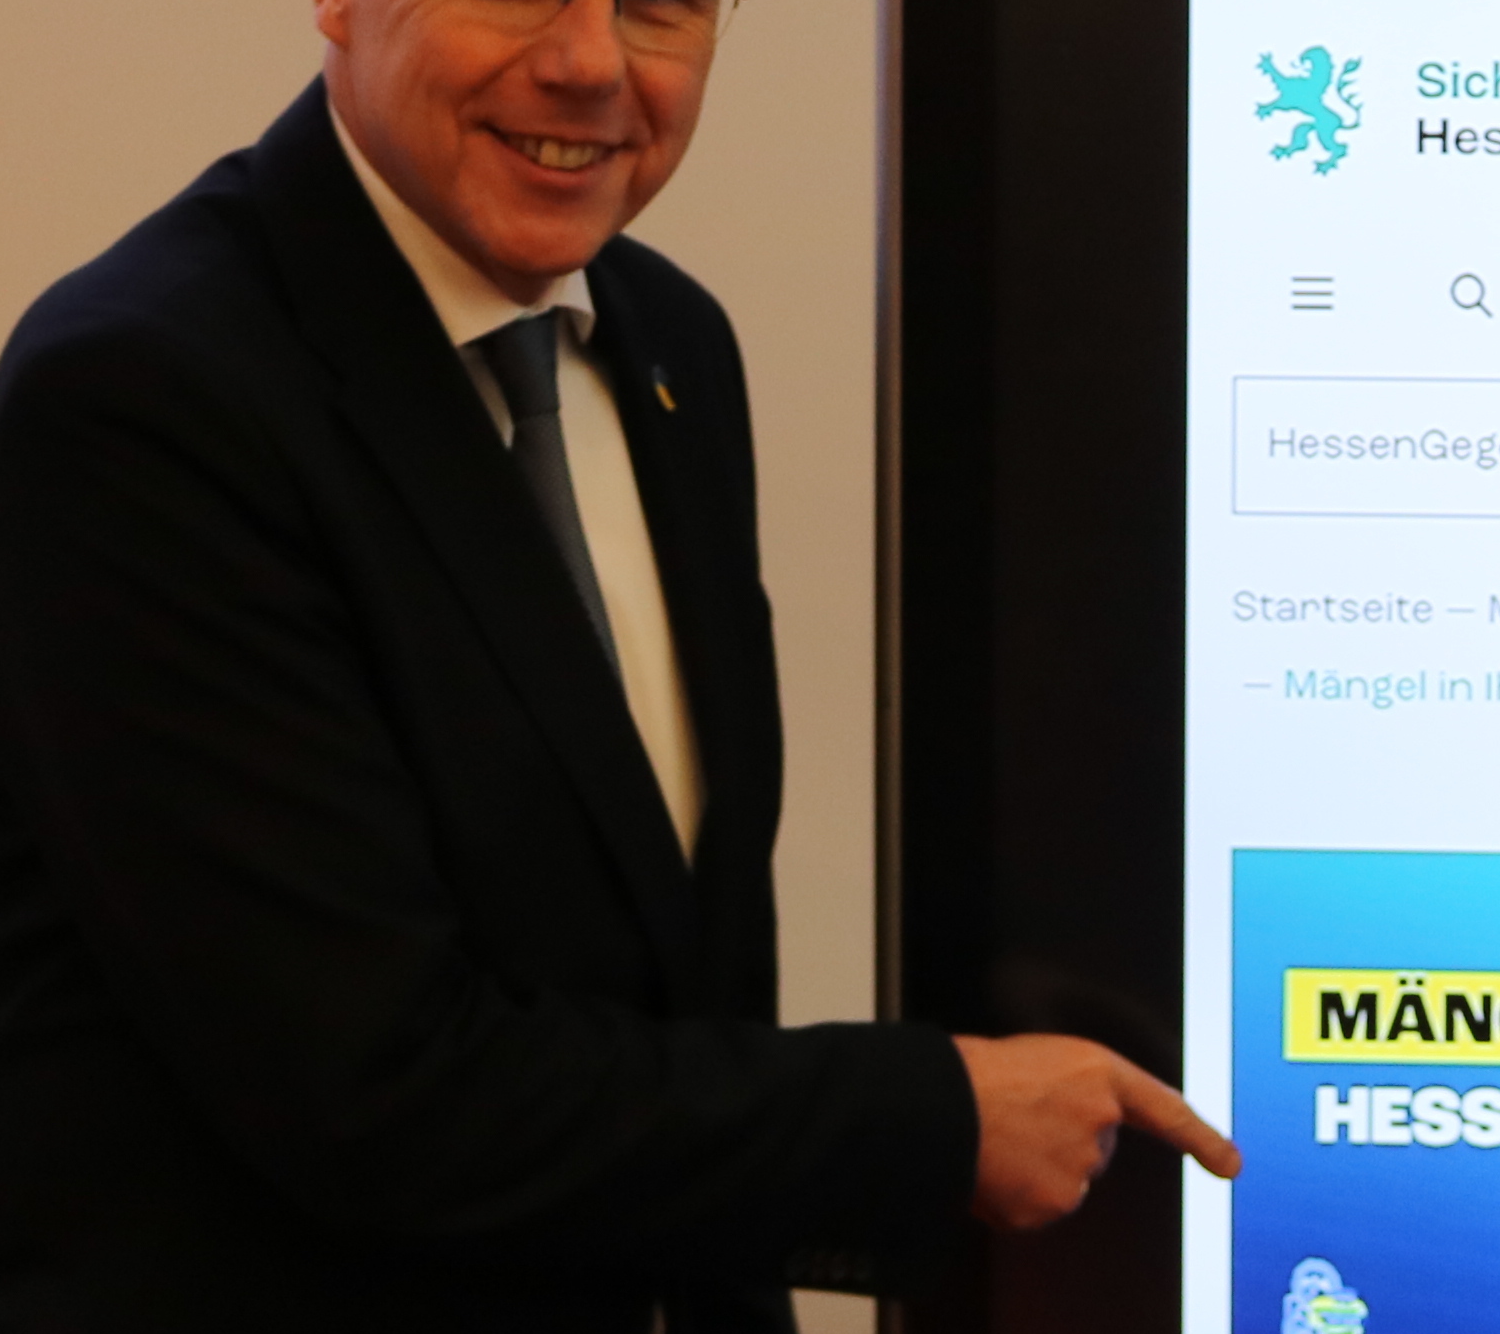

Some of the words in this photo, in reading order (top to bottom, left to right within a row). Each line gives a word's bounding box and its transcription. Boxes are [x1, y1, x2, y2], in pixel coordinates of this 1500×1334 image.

[1231, 588, 1434, 625] Startseite
[1283, 666, 1428, 711] Mängel
[1437, 669, 1474, 703] in
